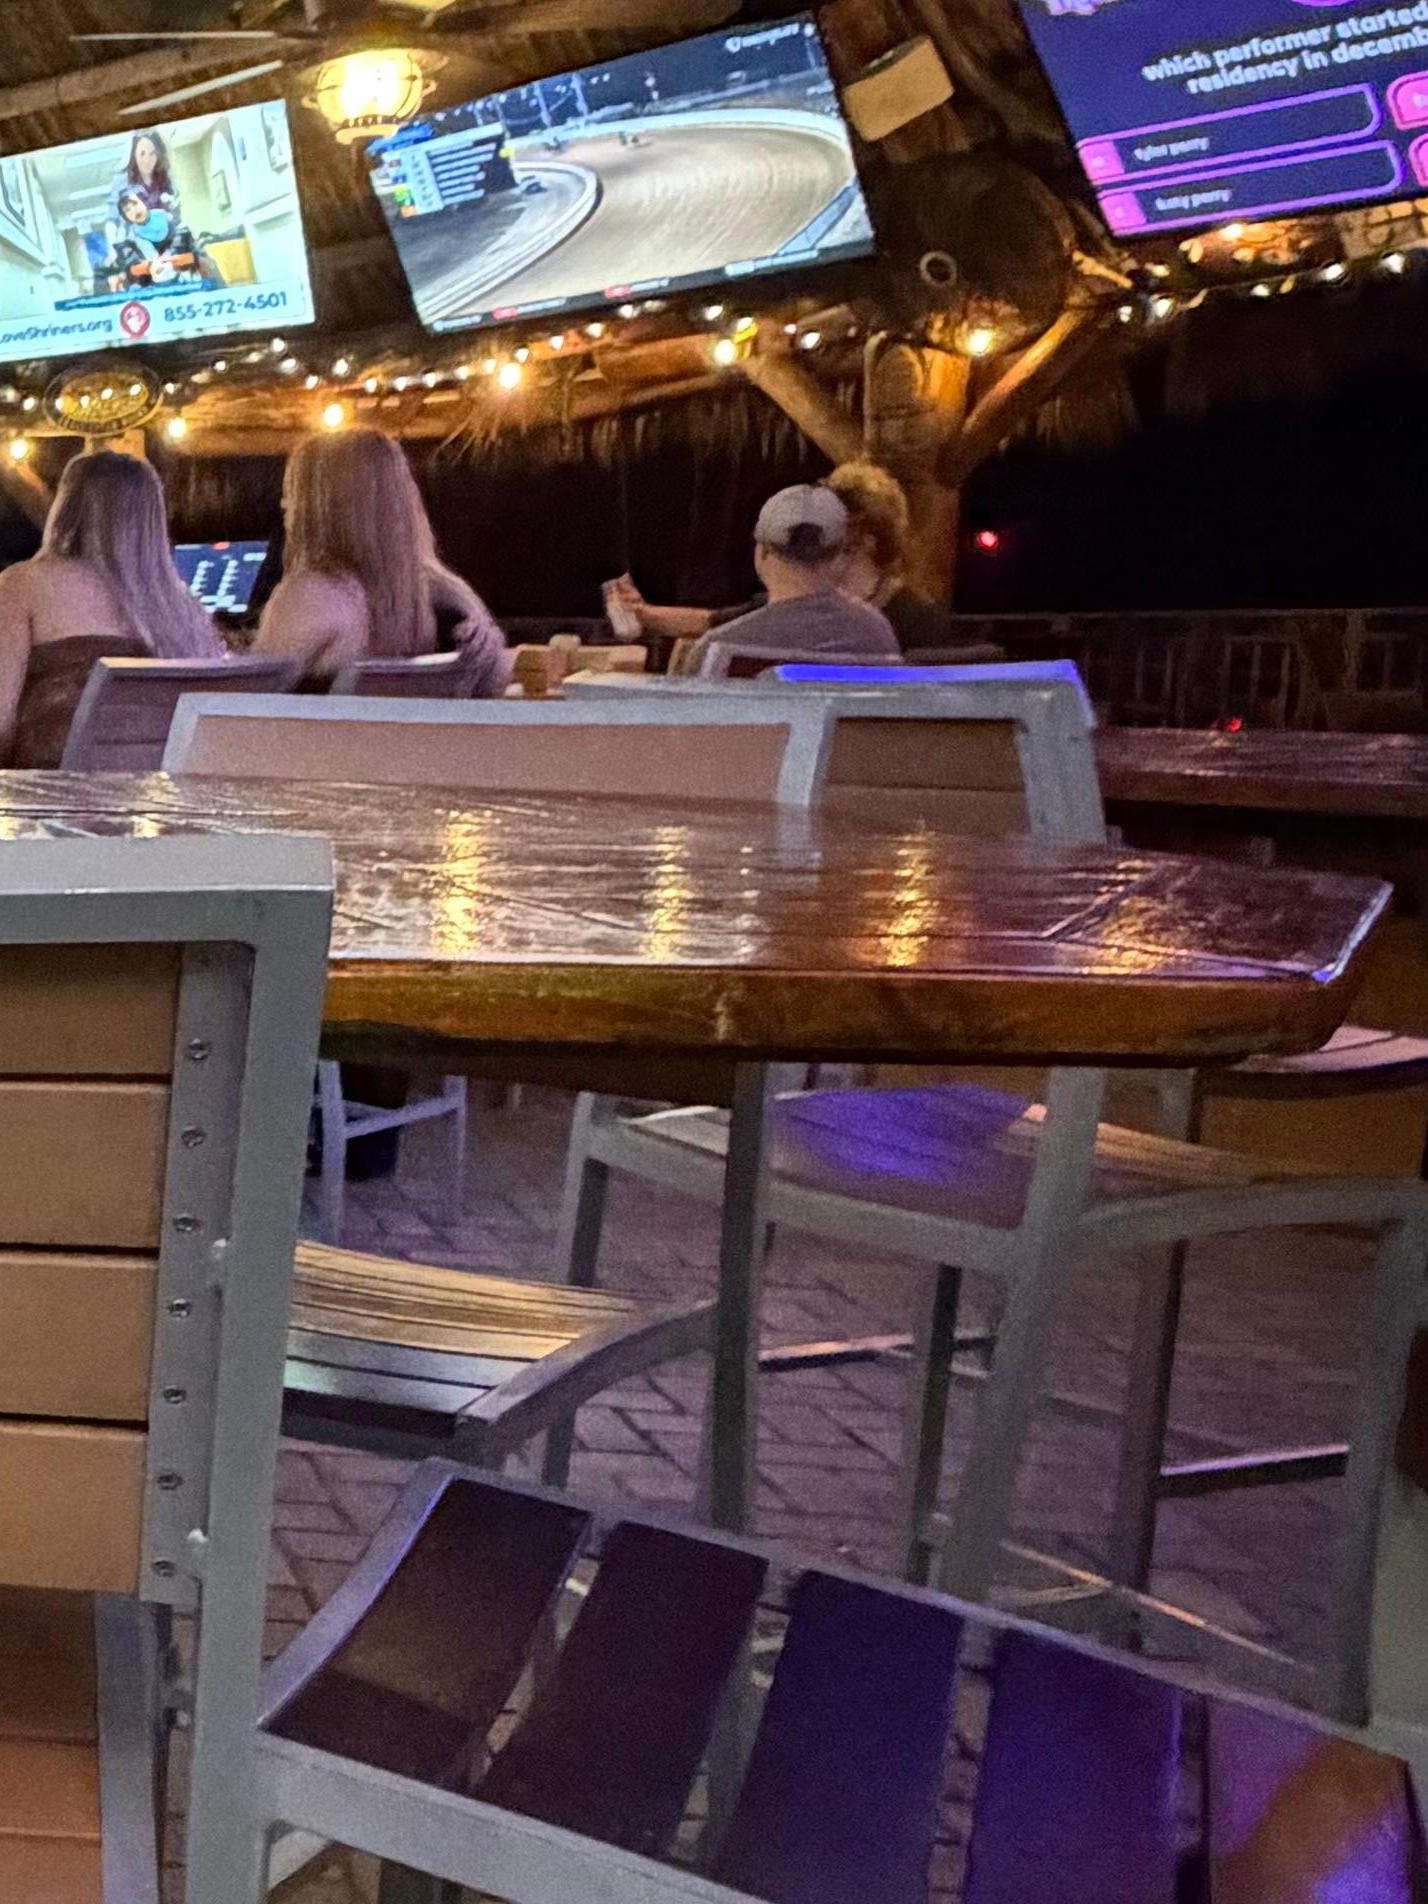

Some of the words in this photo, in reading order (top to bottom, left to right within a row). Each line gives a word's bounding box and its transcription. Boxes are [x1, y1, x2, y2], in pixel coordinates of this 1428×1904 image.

[1142, 50, 1211, 81] which
[1214, 25, 1331, 69] performer
[1335, 0, 1428, 37] started
[1186, 56, 1299, 93] residency
[1302, 49, 1329, 69] in
[163, 291, 288, 322] 855-272-4501
